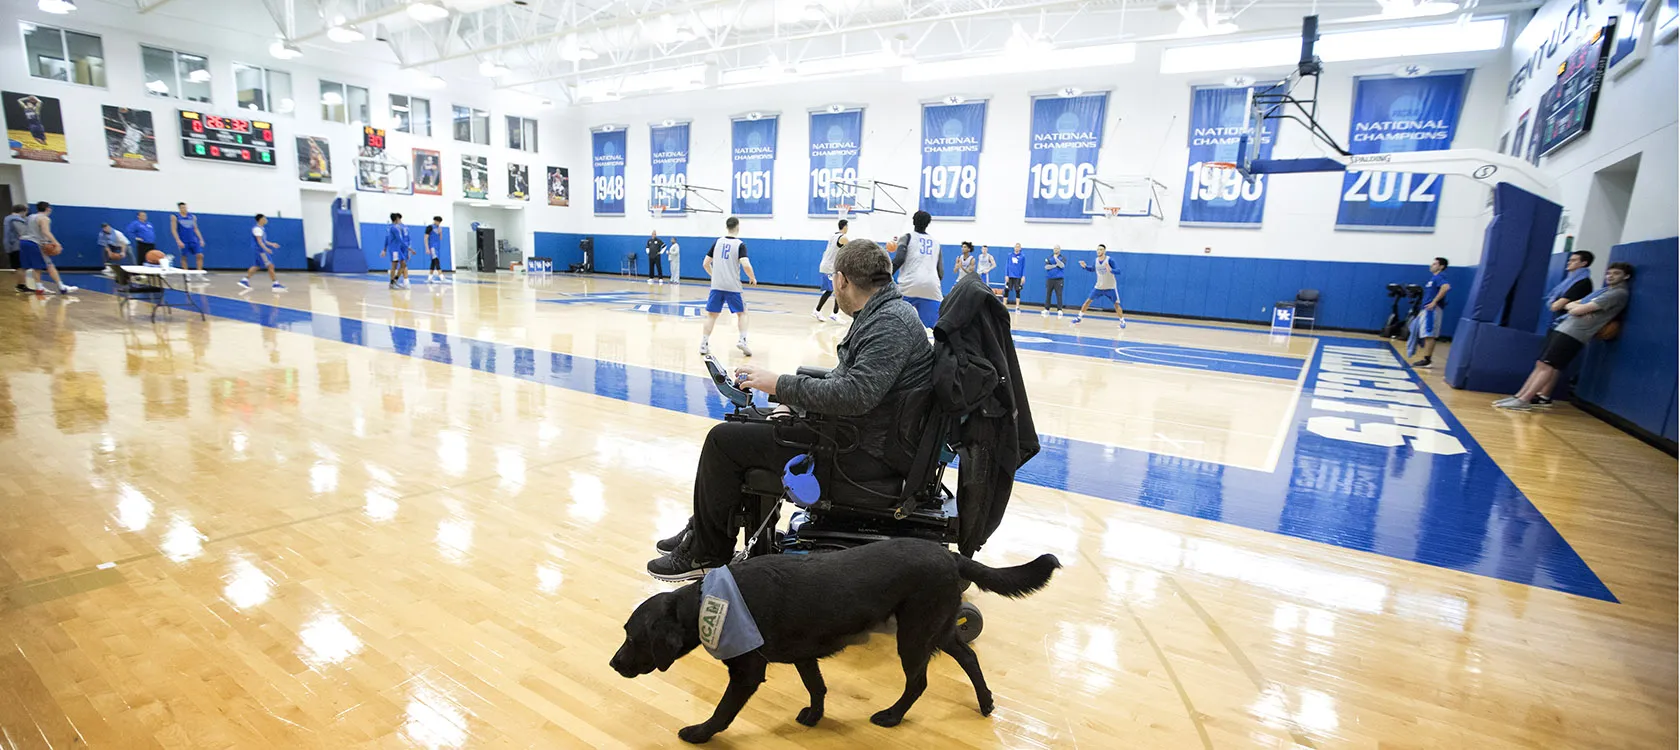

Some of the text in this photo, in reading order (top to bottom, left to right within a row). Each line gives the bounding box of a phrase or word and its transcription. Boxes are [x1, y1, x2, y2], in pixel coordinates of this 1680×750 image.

[205, 114, 249, 132] 26:32
[1355, 119, 1449, 131] NATIONAL
[1034, 131, 1097, 141] NATIONAL
[1195, 126, 1272, 136] NATIOL
[1353, 131, 1448, 142] CHAMPIONS
[368, 134, 383, 149] 30
[812, 141, 857, 150] NATIONAL
[924, 136, 978, 145] NATIONAL
[1033, 141, 1097, 150] CHAMPIONS
[1193, 136, 1271, 146] CHAMPS
[734, 146, 773, 154] NATIONAL
[812, 149, 857, 157] CHAMPIONS
[924, 144, 978, 153] CHAMPIONS
[653, 157, 687, 165] CHAMPIONS
[734, 153, 774, 161] CHAMPIONS
[734, 170, 771, 199] 1951
[922, 165, 977, 199] 1978
[1031, 162, 1096, 200] 1996
[1343, 170, 1441, 202] 2012
[594, 175, 624, 200] 1948
[721, 243, 731, 260] 12
[919, 237, 933, 256] 32
[1306, 345, 1468, 456] WILDCATS
[701, 600, 721, 643] ICAN
